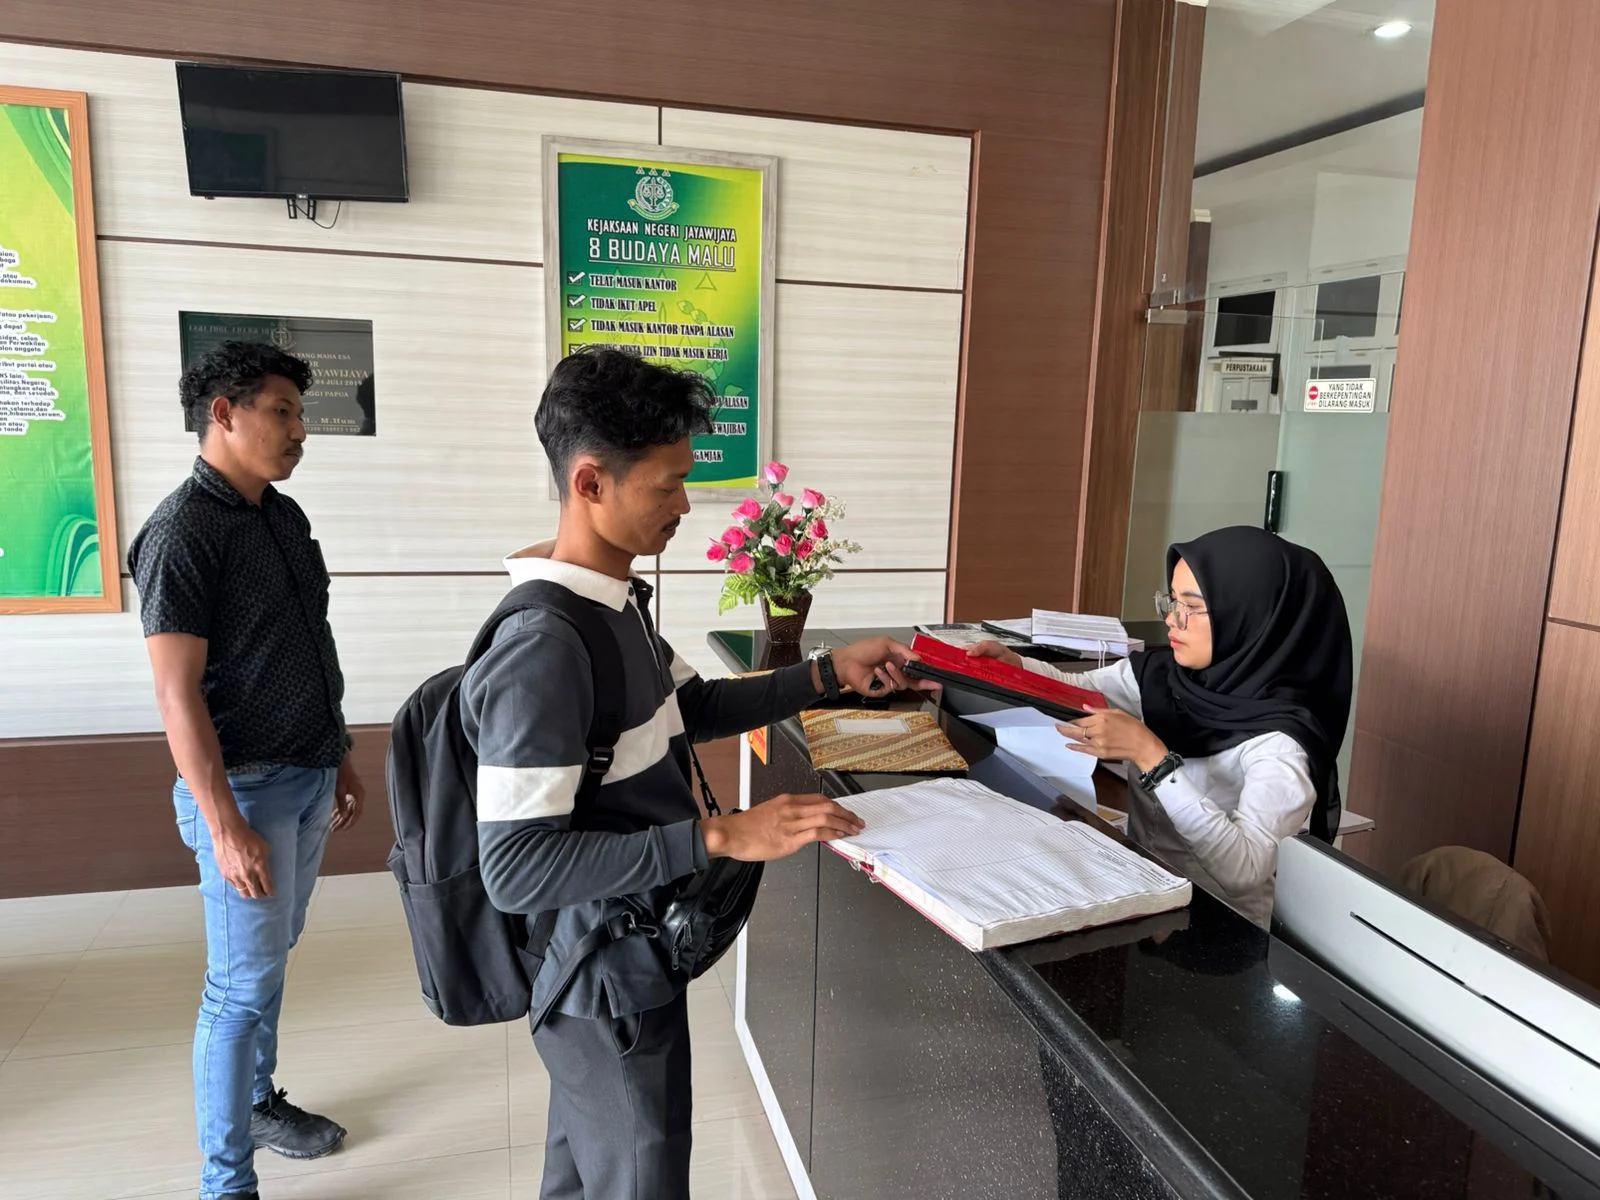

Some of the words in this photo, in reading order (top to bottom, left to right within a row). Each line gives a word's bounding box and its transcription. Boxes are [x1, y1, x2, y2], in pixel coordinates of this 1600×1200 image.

[587, 218, 638, 235] KEJAKSAAN
[644, 222, 680, 237] NEGERI
[684, 226, 737, 243] JAYAWIJAYA
[589, 237, 601, 259] 8
[608, 238, 681, 264] BUDAYA
[688, 244, 735, 267] MALU
[589, 274, 614, 287] TELAT
[616, 276, 643, 289] MASUK
[645, 278, 677, 291] KANTOR
[591, 297, 615, 310] TIDAK
[617, 299, 635, 311] IKUT
[638, 300, 657, 312] APEL
[591, 320, 616, 332] TIDAK
[618, 321, 644, 333] MASUK
[646, 322, 678, 335] KANTOR
[680, 323, 705, 336] TANPA
[707, 325, 734, 338] ALASAN
[643, 345, 657, 357] IZIN
[659, 346, 681, 358] TIDAK
[683, 347, 705, 359] MASUK
[706, 348, 728, 361] KERJA
[1328, 383, 1345, 391] YANG
[1346, 383, 1364, 391] TIDAK
[724, 396, 748, 409] ALASAN
[1318, 400, 1348, 408] DILARANG
[1349, 400, 1371, 408] MASUK
[712, 423, 746, 435] EWAJIBAN
